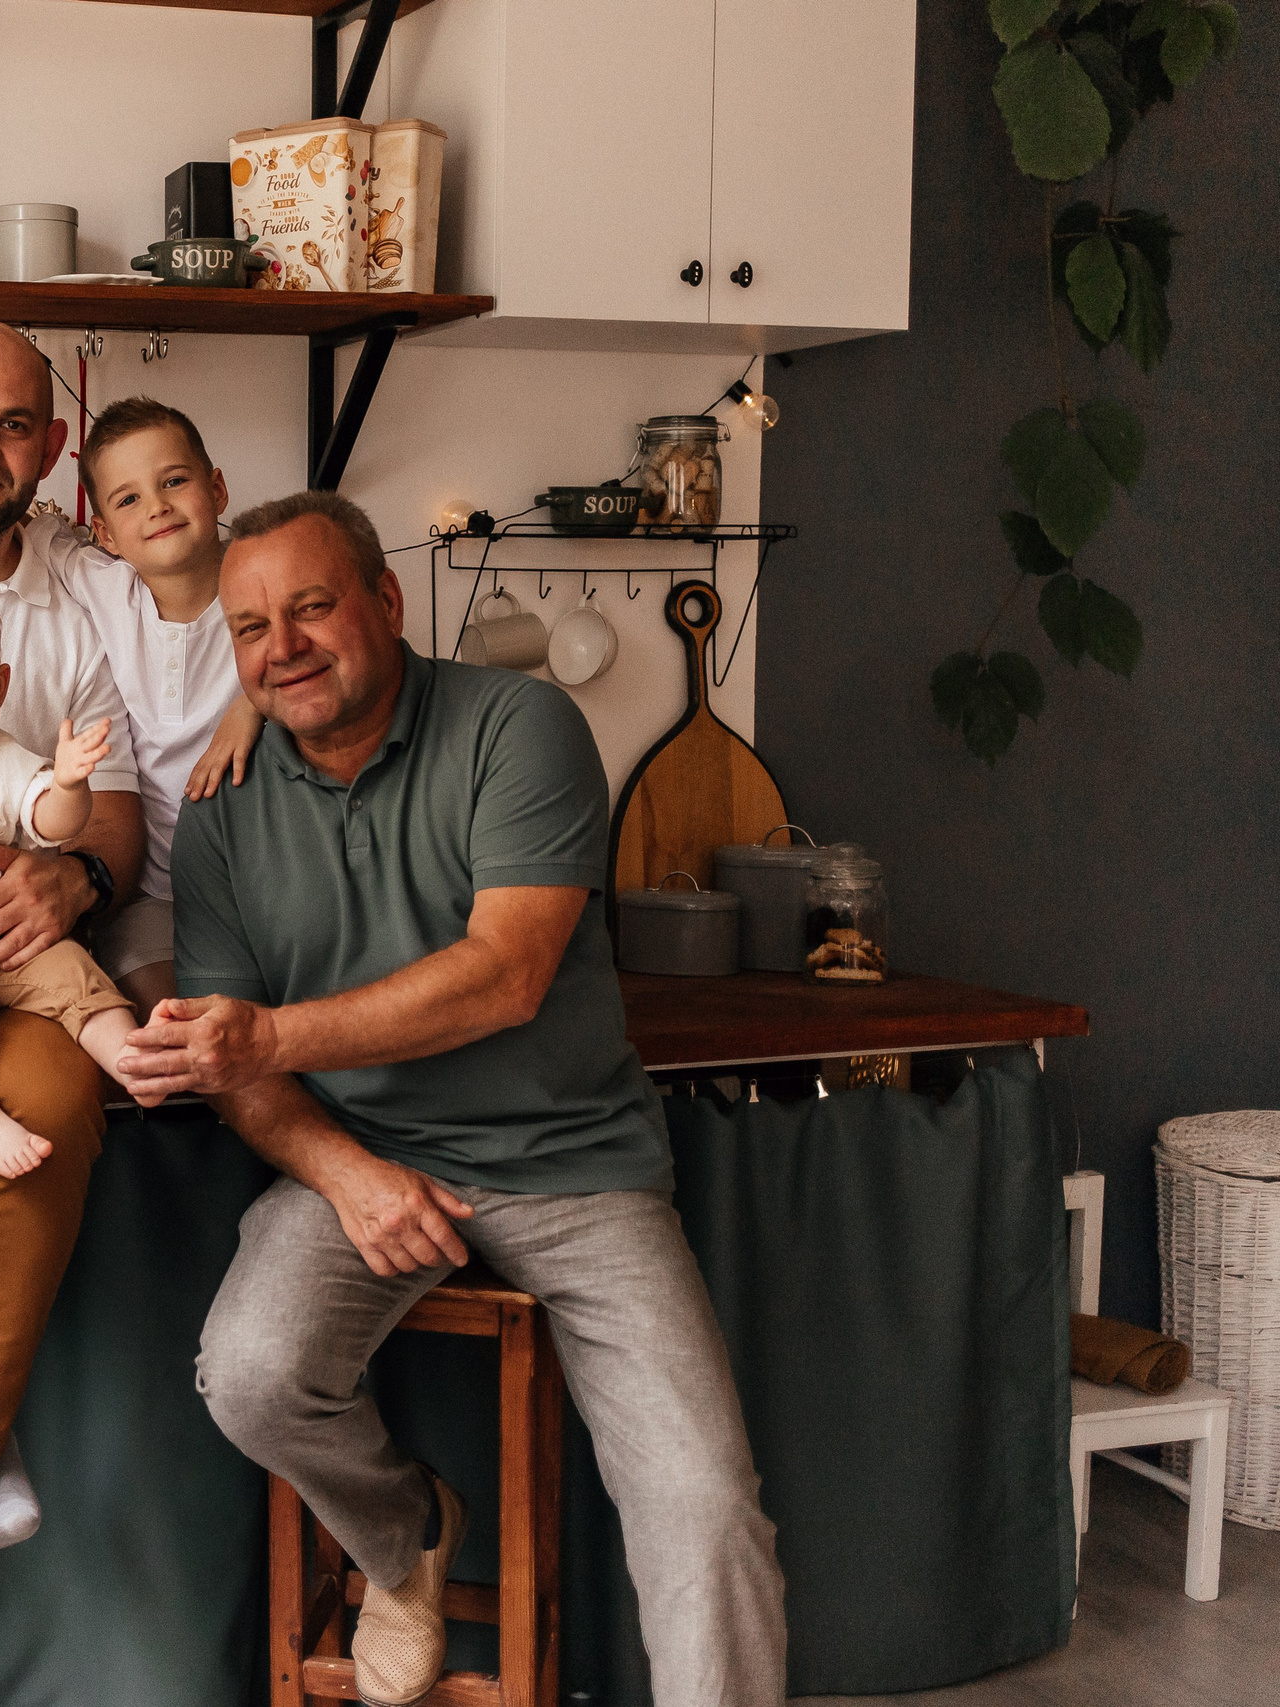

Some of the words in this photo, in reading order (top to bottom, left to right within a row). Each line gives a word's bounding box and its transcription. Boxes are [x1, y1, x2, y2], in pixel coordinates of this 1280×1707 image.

[266, 172, 301, 192] Food
[261, 216, 310, 236] Friends
[172, 249, 234, 269] SOUP
[584, 496, 637, 514] SOUP
